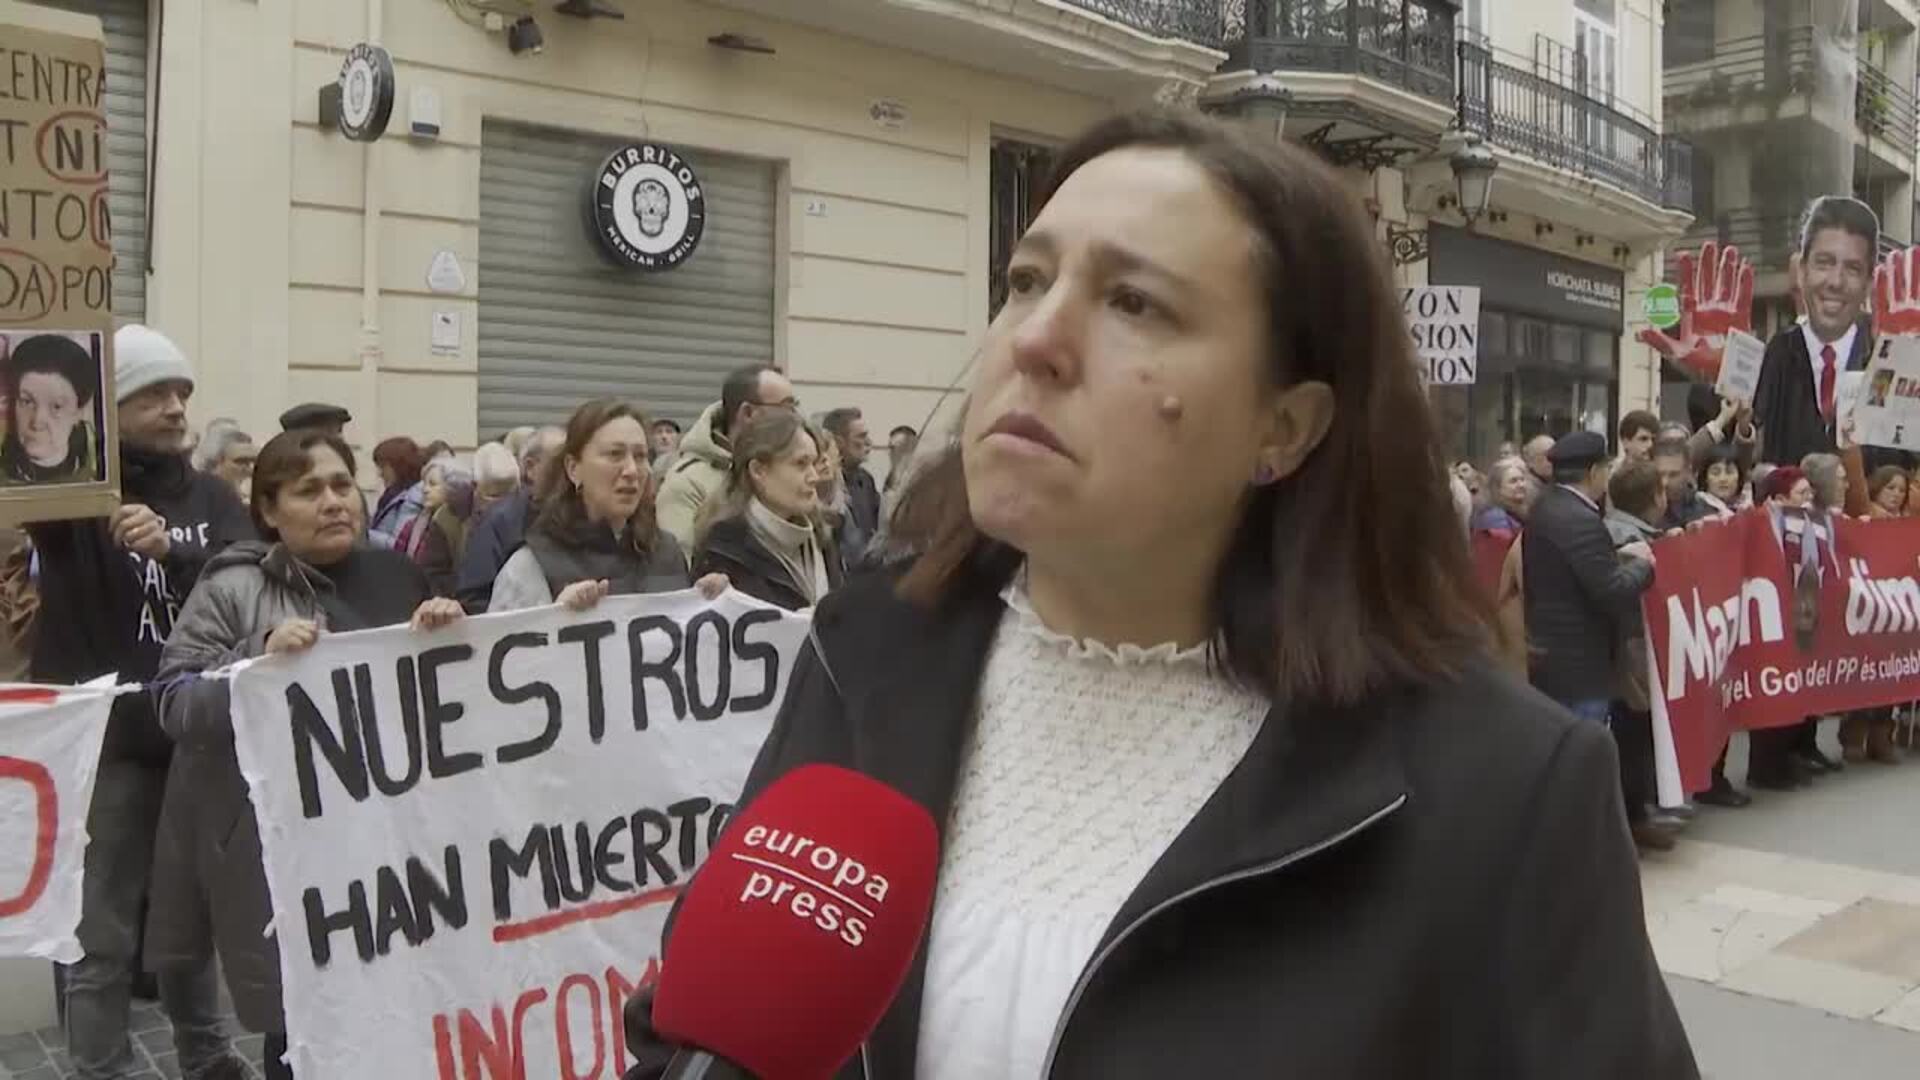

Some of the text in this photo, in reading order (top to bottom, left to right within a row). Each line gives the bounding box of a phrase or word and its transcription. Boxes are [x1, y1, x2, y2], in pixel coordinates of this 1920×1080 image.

[602, 145, 700, 200] BURRITOS
[607, 226, 695, 265] MEXICAN GRILL
[1806, 659, 1832, 687] del
[1835, 657, 1858, 684] PP
[285, 610, 782, 819] NUESTROS
[743, 825, 889, 902] europa
[302, 845, 468, 967] HAN
[739, 872, 867, 946] press
